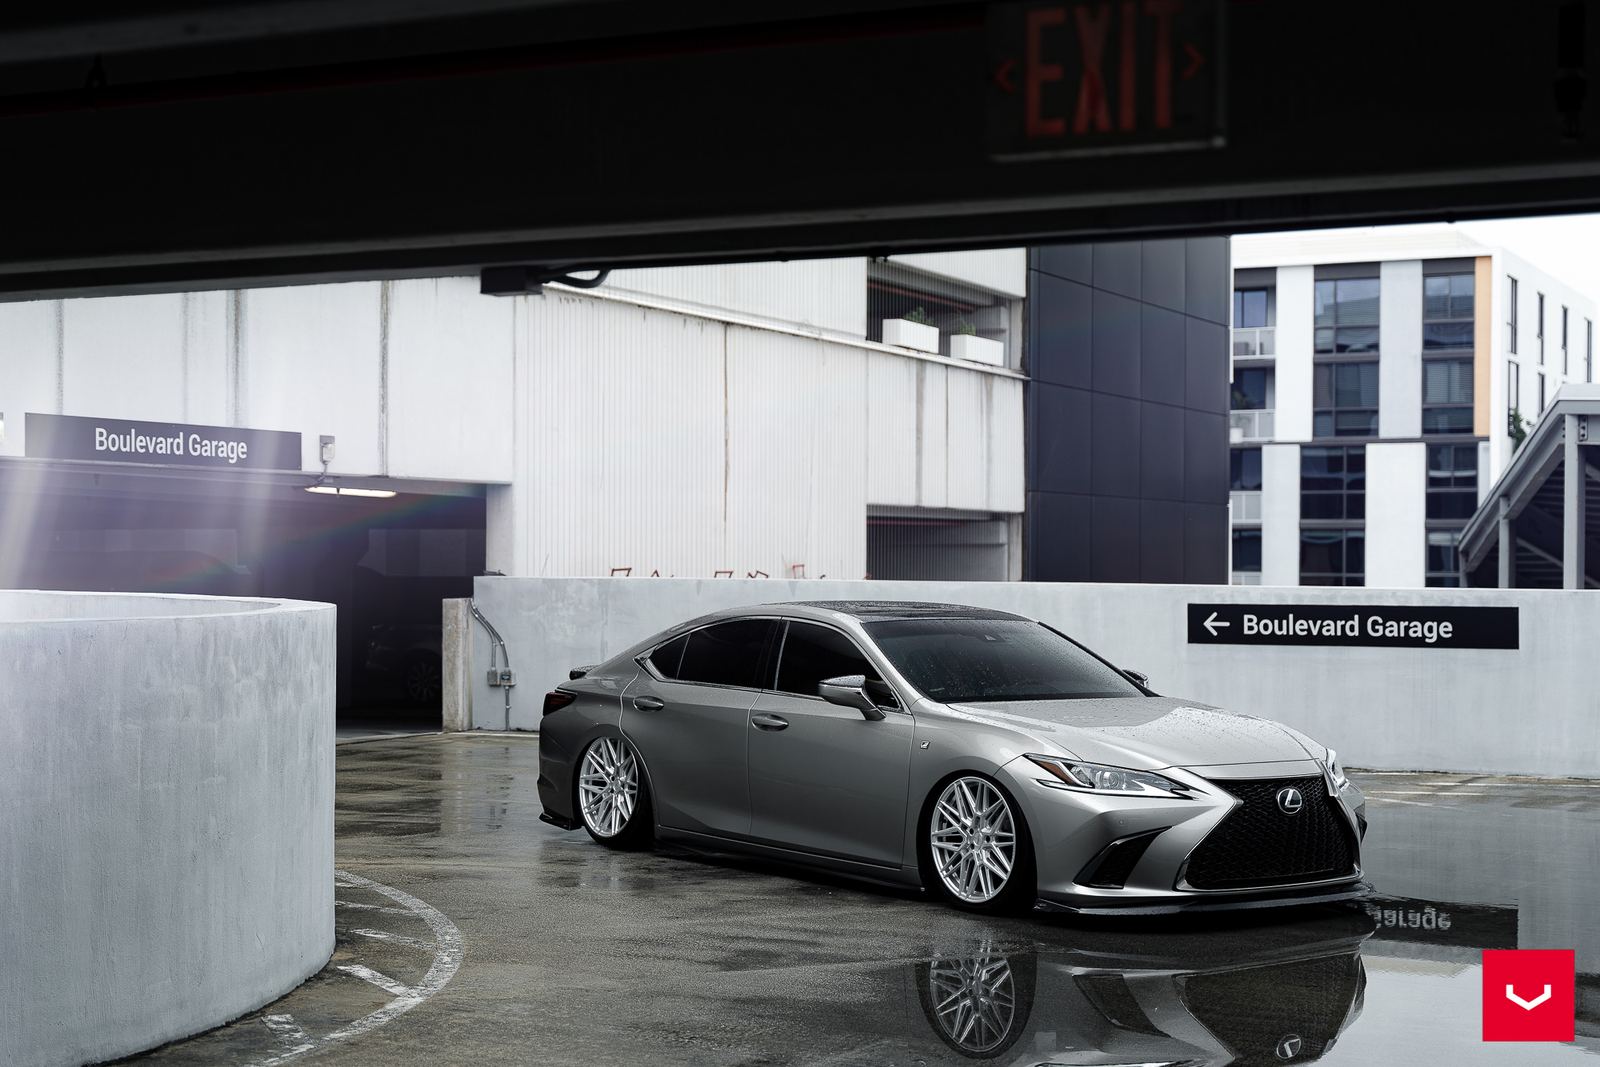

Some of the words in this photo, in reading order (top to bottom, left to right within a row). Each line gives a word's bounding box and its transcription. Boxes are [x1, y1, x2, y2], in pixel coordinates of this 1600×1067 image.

[1024, 0, 1184, 140] EXIT
[95, 427, 184, 455] Boulevard
[188, 433, 248, 464] Garage
[1242, 614, 1360, 637] Boulevard
[1366, 616, 1453, 643] Garage
